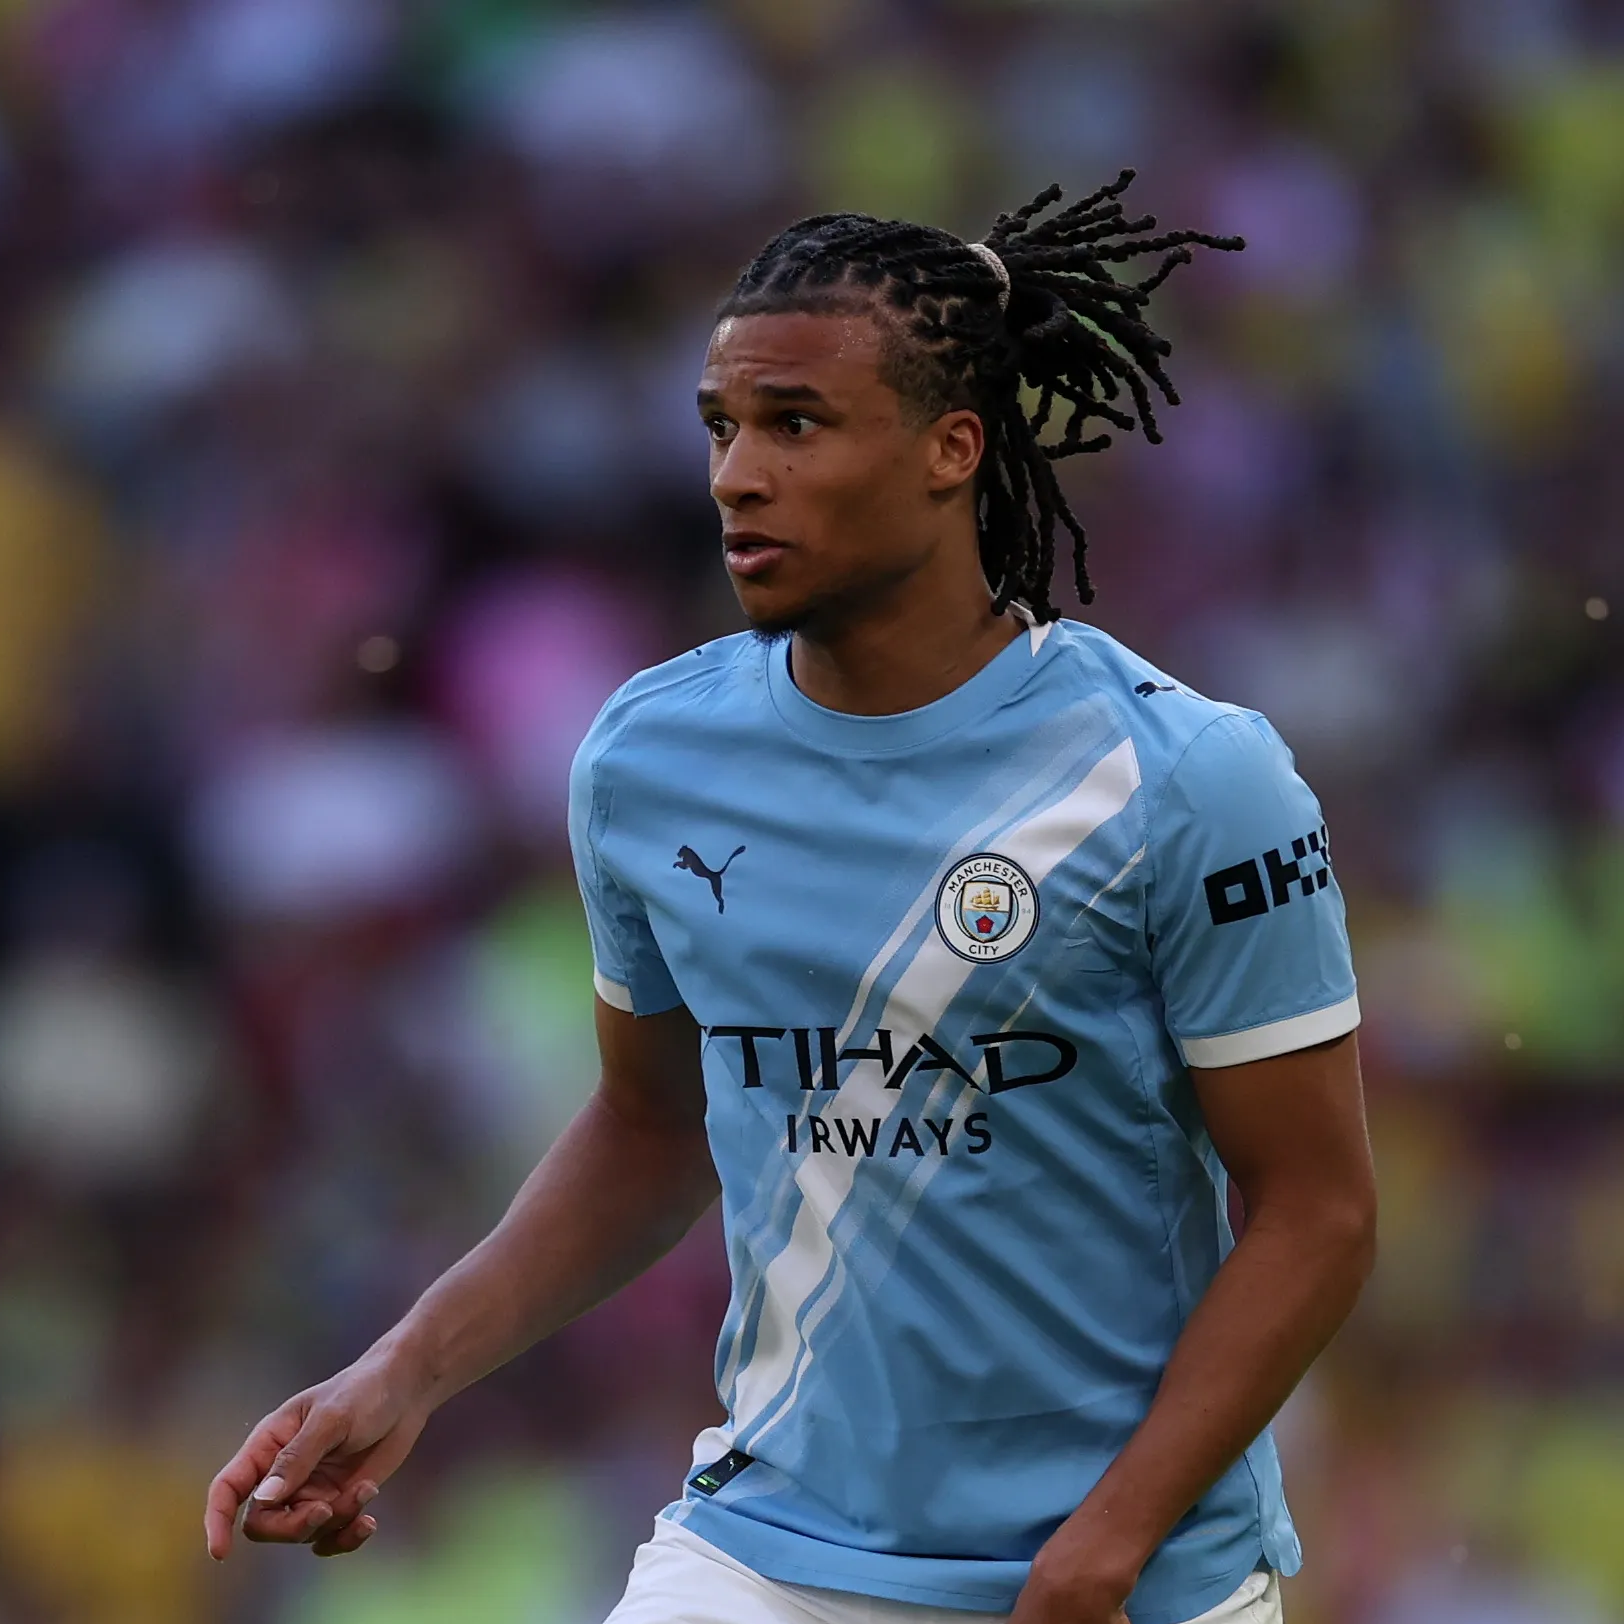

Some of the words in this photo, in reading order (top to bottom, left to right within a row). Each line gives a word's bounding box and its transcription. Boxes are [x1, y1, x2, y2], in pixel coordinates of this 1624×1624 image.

[948, 862, 1028, 898] MANCHESTER
[968, 944, 1000, 956] CITY
[700, 1026, 1078, 1095] TIHAD
[786, 1112, 992, 1158] IRWAYS
